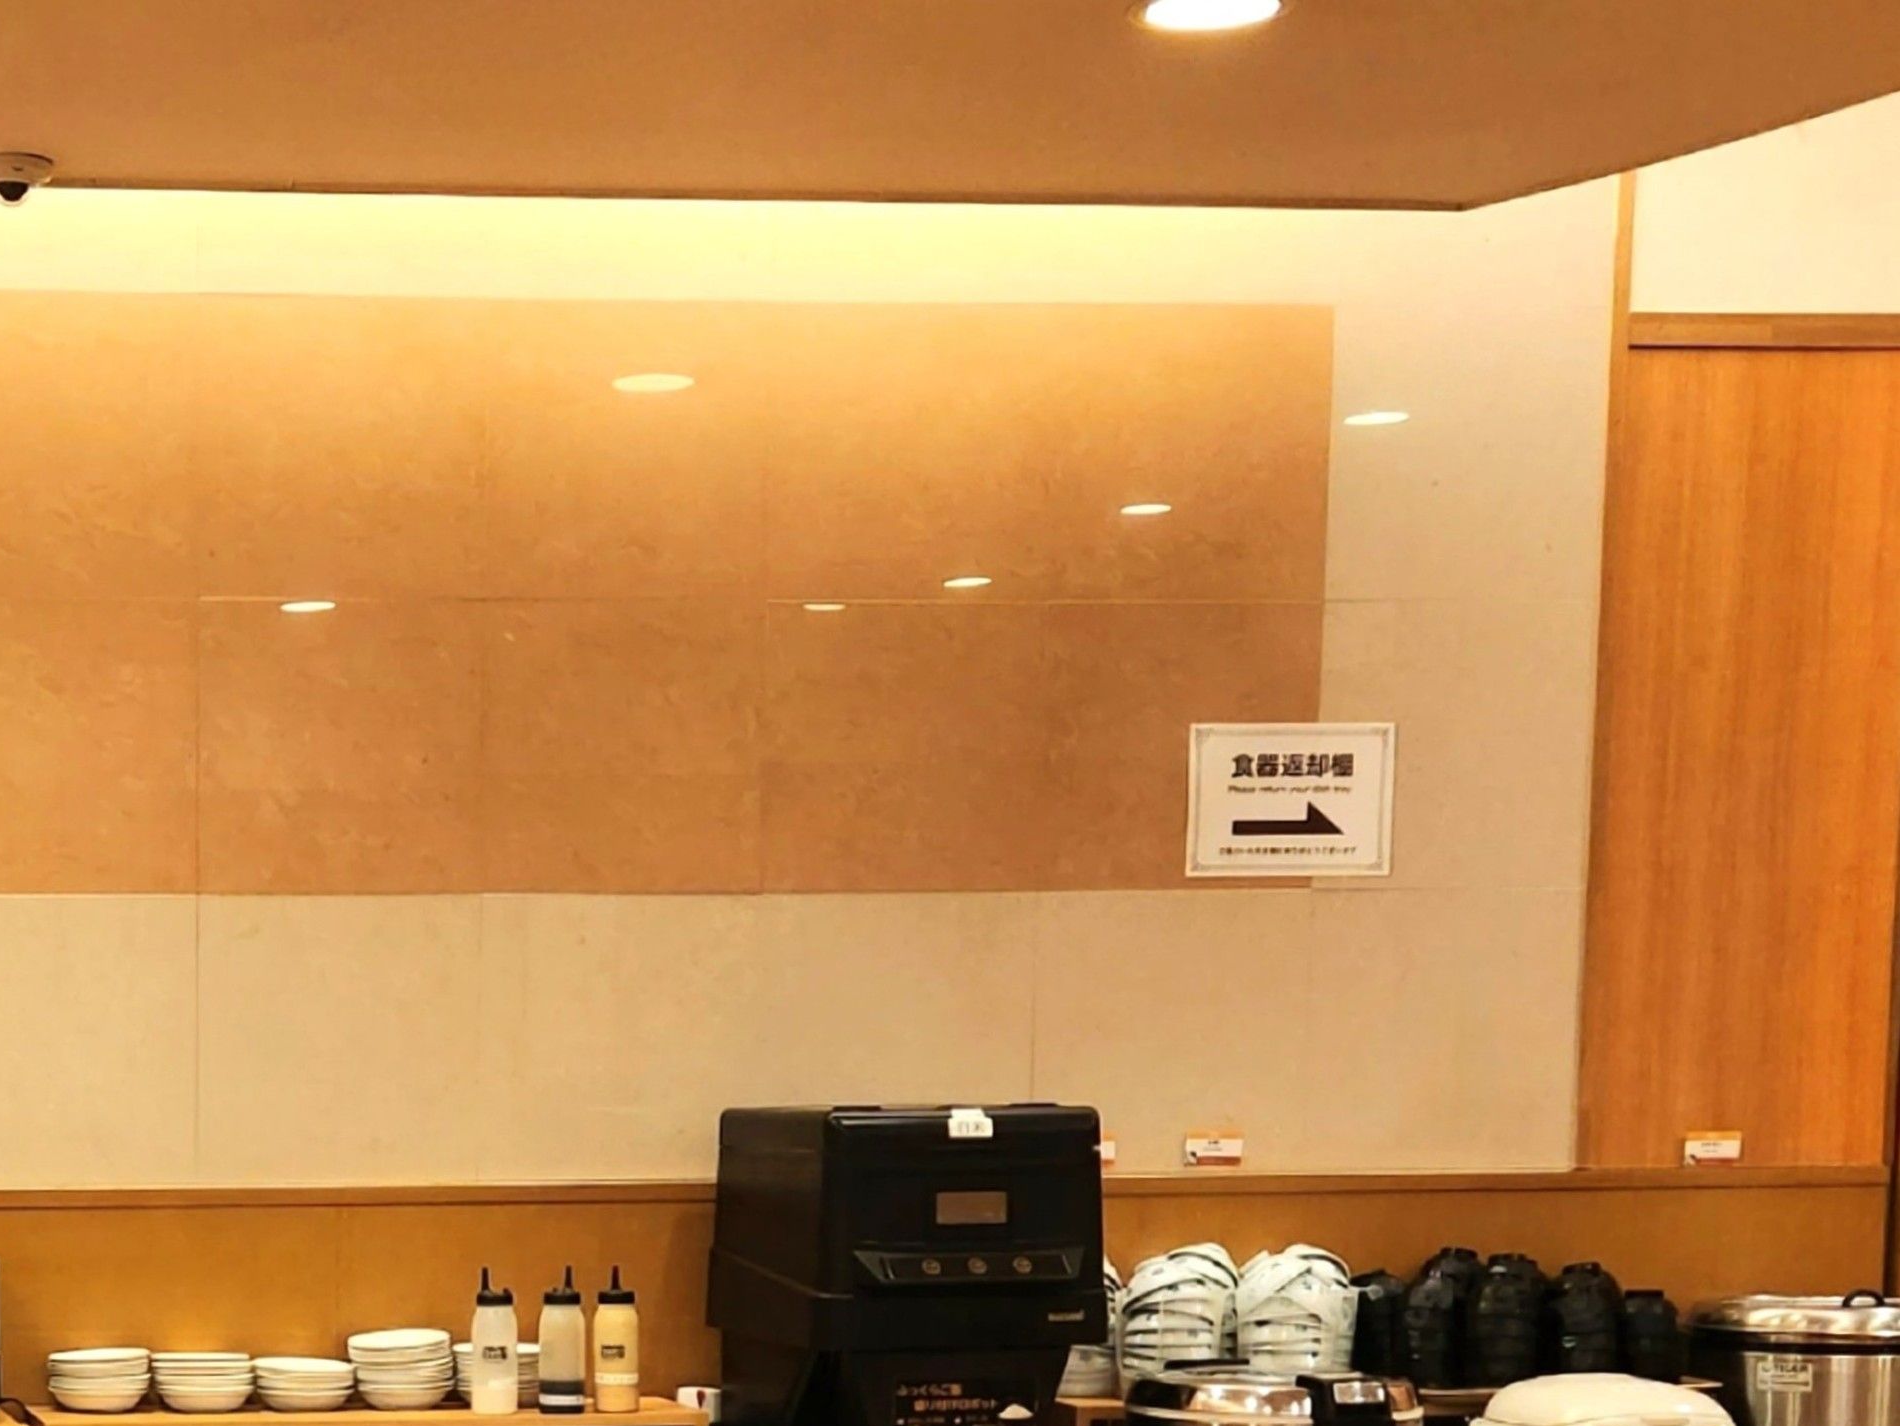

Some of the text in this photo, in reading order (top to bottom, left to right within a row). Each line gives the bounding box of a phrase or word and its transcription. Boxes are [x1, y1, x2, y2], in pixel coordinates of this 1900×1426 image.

[1231, 753, 1354, 778] 食器返却棚
[1227, 785, 1256, 794] Please
